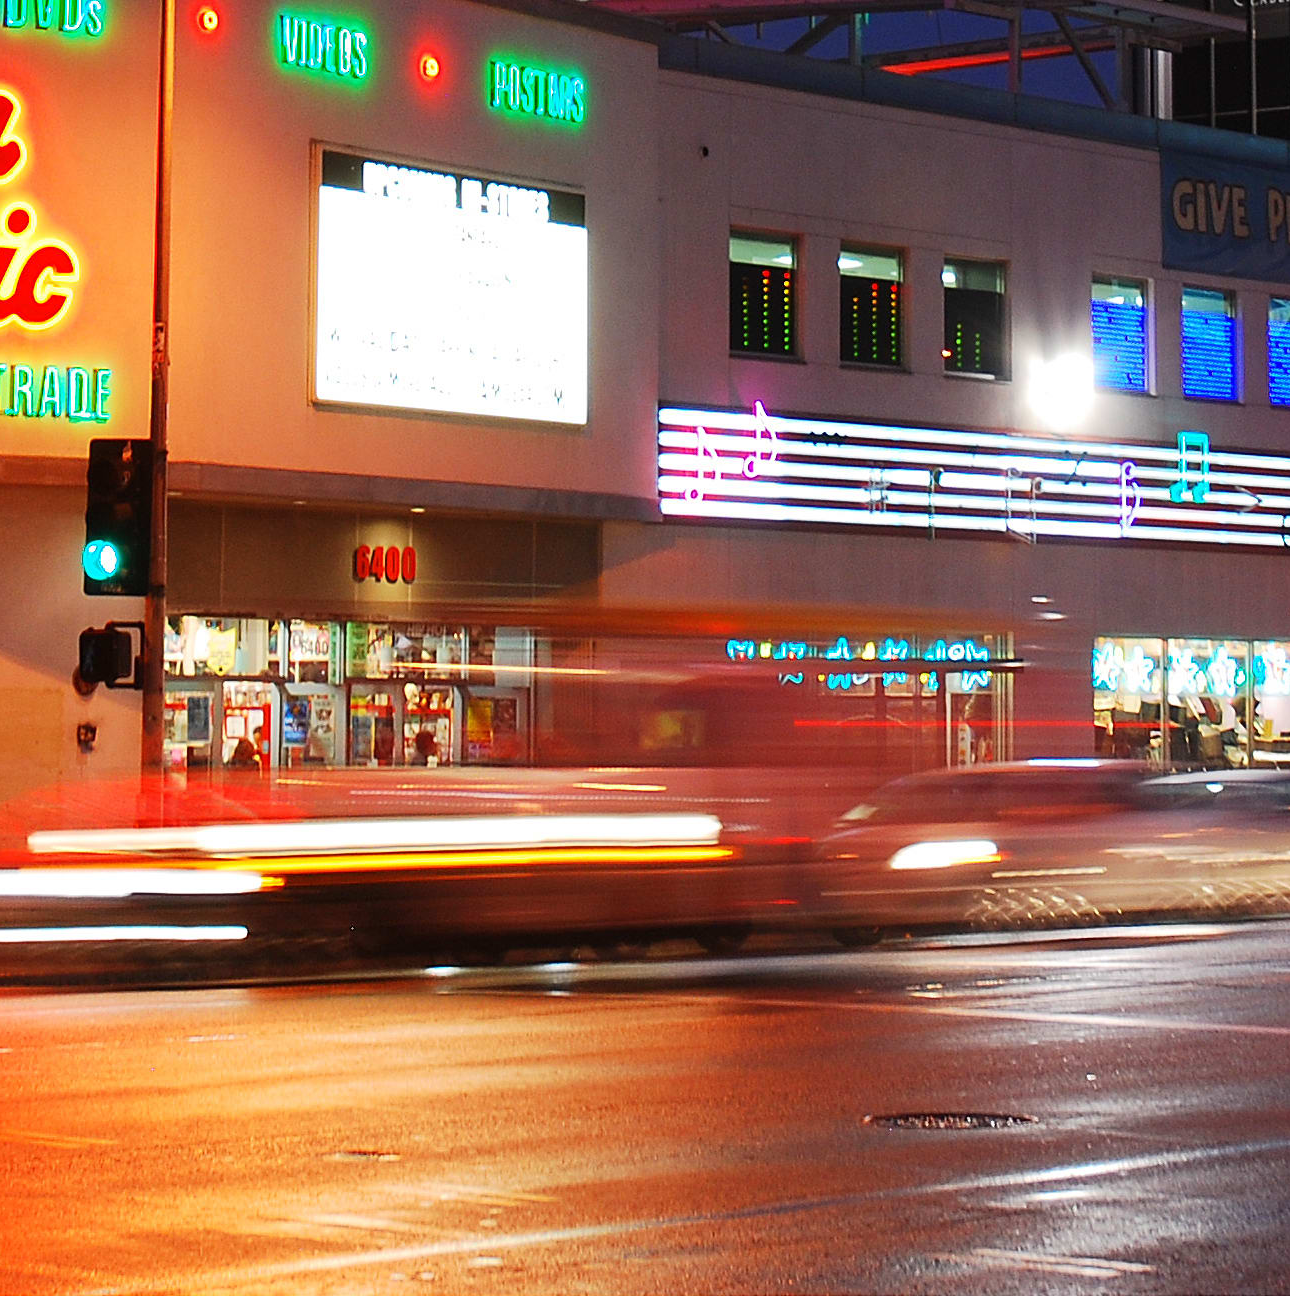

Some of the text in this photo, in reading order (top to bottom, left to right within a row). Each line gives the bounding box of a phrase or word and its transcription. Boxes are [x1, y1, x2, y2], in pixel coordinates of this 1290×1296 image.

[280, 13, 369, 79] VIDEOS
[490, 61, 585, 124] POSTERS
[1171, 178, 1250, 239] GIVE
[353, 543, 417, 585] 6400
